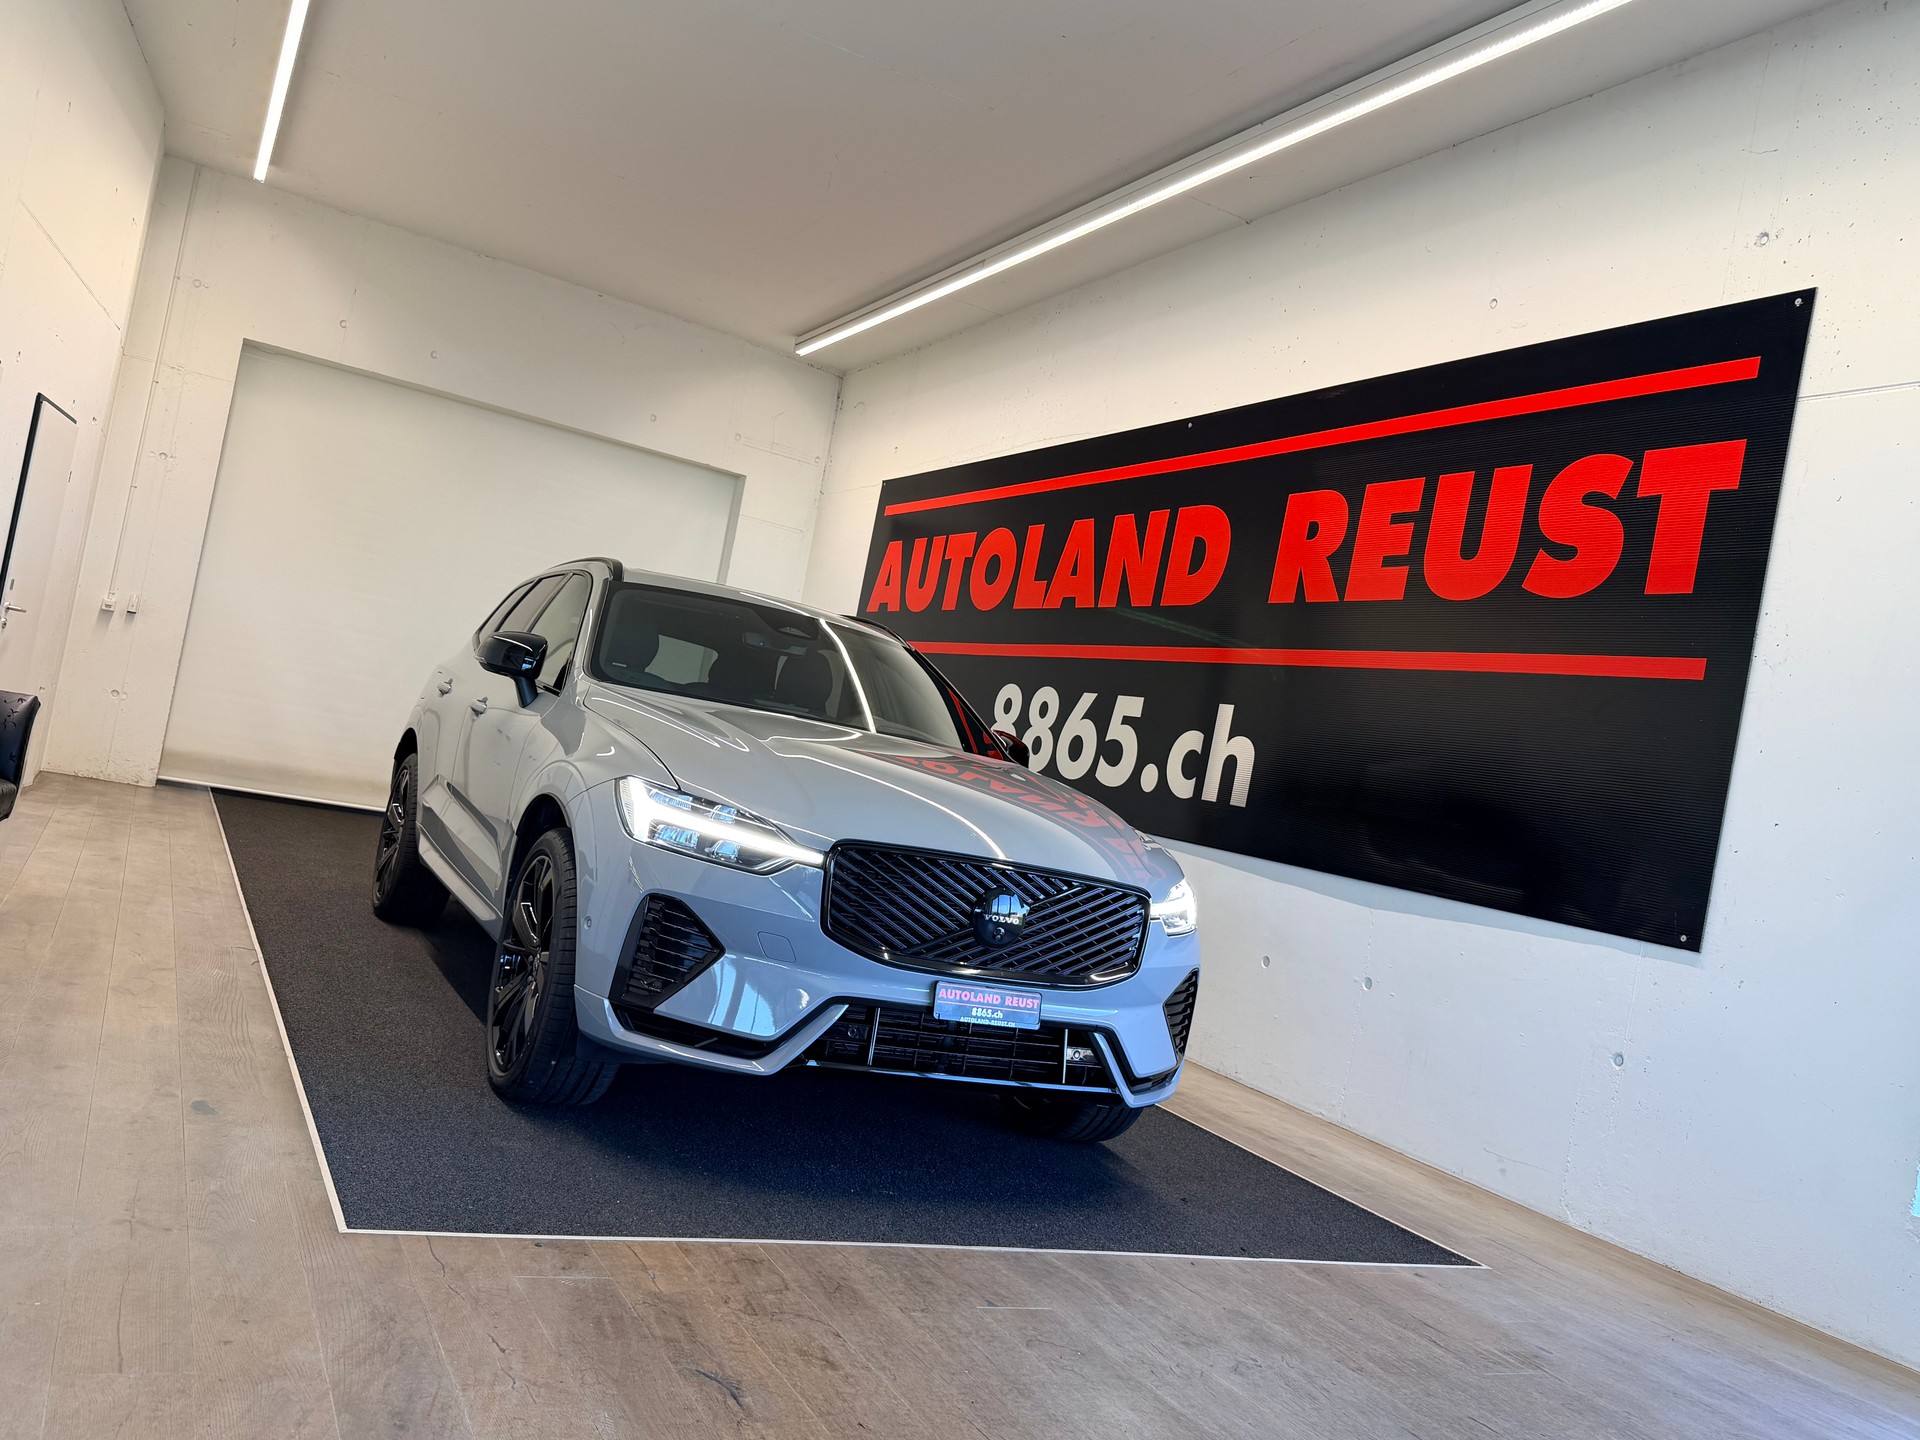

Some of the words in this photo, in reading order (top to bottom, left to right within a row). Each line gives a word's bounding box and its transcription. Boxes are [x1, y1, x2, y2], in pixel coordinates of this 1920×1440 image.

[867, 504, 1232, 613] AUTOLAND
[1267, 438, 1747, 604] REUST
[990, 683, 1256, 808] 8865.ch
[983, 913, 1020, 925] VOLVO
[939, 988, 1001, 1005] AUTOLAND
[1004, 996, 1040, 1009] REUST
[971, 1007, 1003, 1019] 8865.ch
